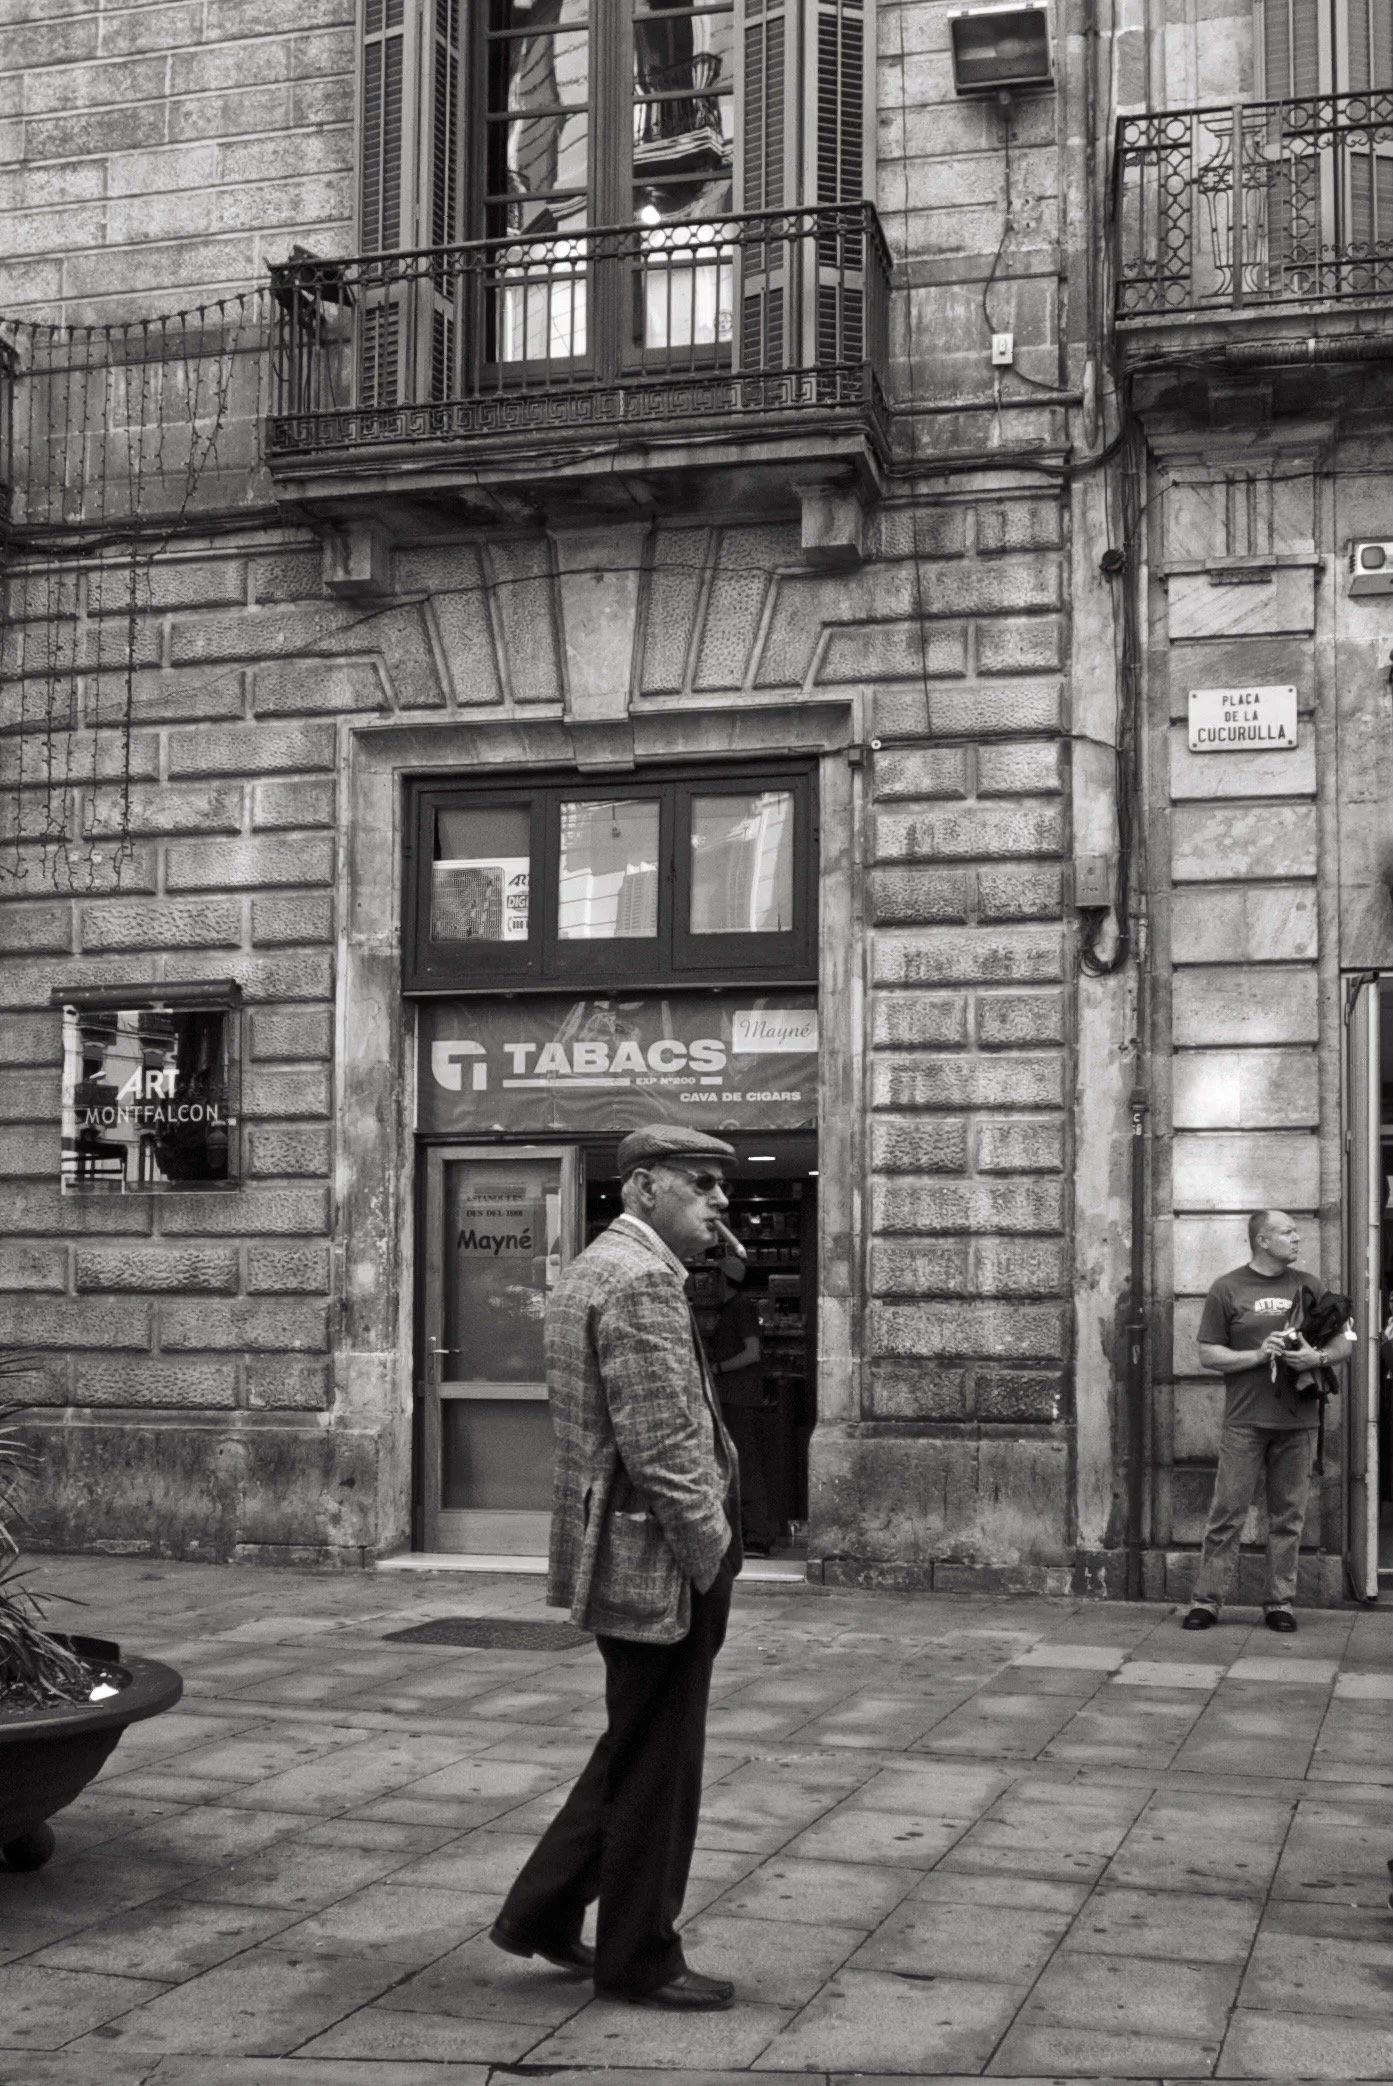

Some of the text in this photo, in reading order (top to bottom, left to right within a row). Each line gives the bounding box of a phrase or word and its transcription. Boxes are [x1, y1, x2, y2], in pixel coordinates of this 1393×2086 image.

[1224, 710, 1259, 722] DE LA
[1197, 724, 1286, 743] CUCURULLA
[739, 1018, 811, 1045] Mayné
[503, 1039, 727, 1074] TABACS
[116, 1065, 180, 1101] ART
[635, 1077, 658, 1086] EXP
[680, 1091, 802, 1102] CAVA DE CIGARS
[85, 1103, 220, 1125] MONTFALCON
[457, 1228, 532, 1255] Mayné
